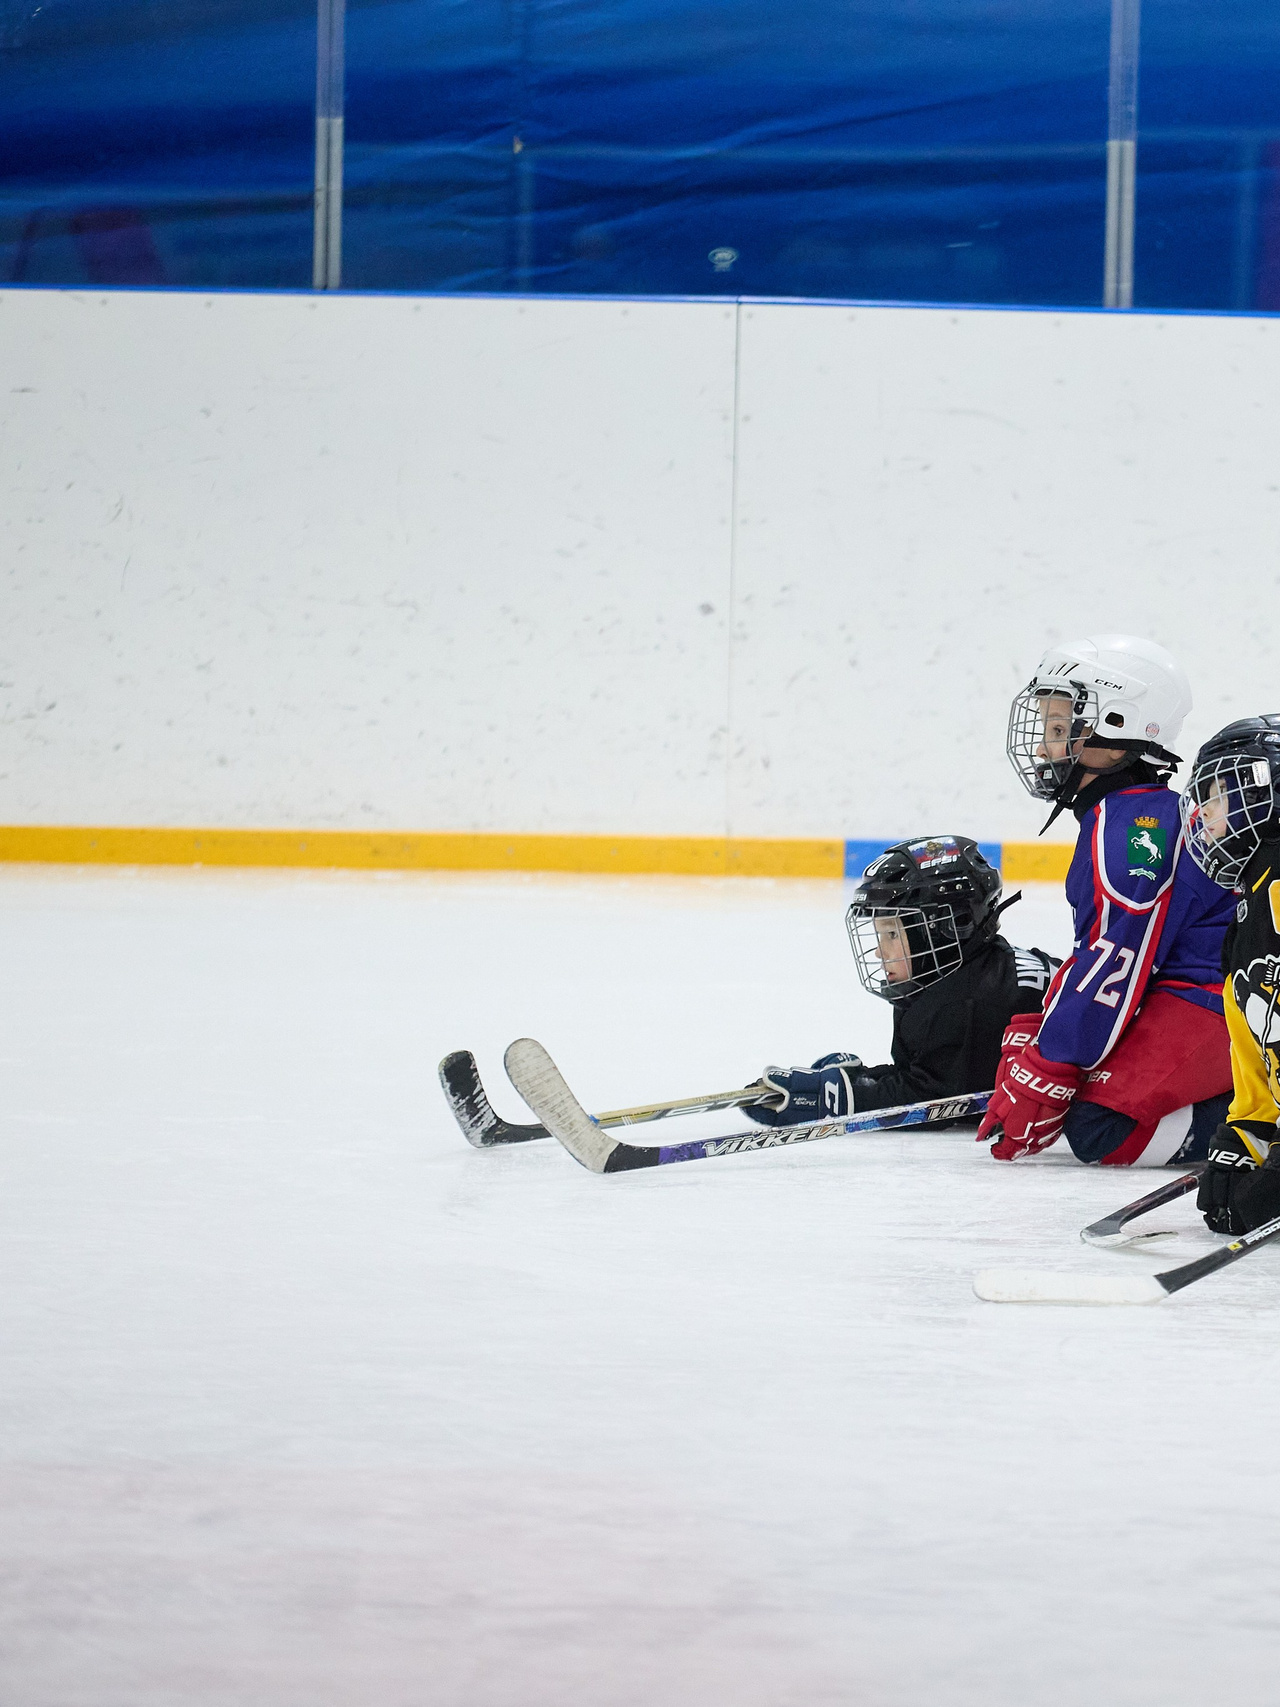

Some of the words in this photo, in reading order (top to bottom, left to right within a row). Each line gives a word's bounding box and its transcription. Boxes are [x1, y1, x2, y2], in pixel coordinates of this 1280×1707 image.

[1094, 678, 1123, 690] CCM
[1076, 937, 1136, 1009] 72
[1009, 1062, 1077, 1101] BAUER
[702, 1122, 847, 1158] VIKKELA
